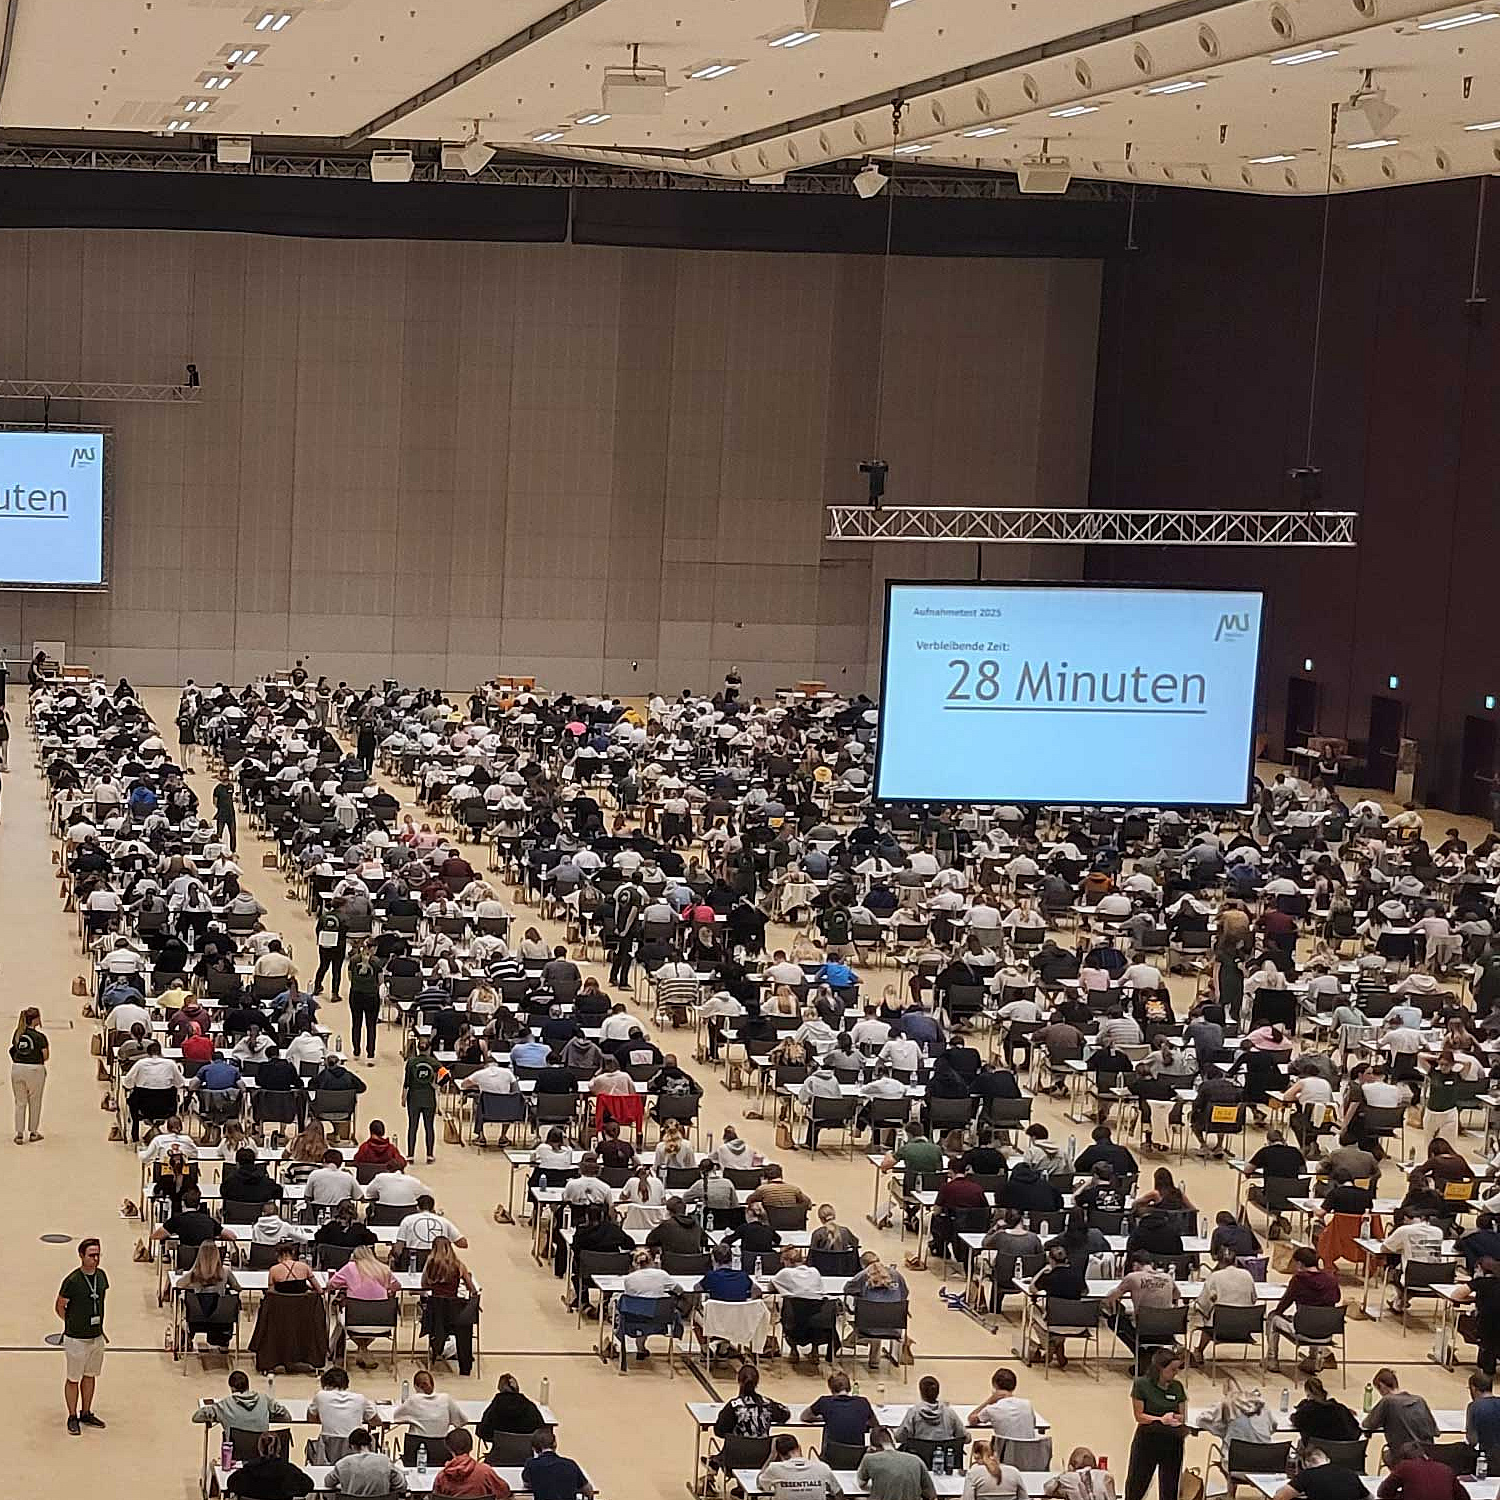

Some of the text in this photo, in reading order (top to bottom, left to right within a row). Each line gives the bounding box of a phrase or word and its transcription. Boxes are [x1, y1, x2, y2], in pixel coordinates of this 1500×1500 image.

[979, 608, 1002, 618] 2025
[916, 641, 1010, 652] Verbleibende Zeit:
[946, 659, 1206, 705] 28 Minuten
